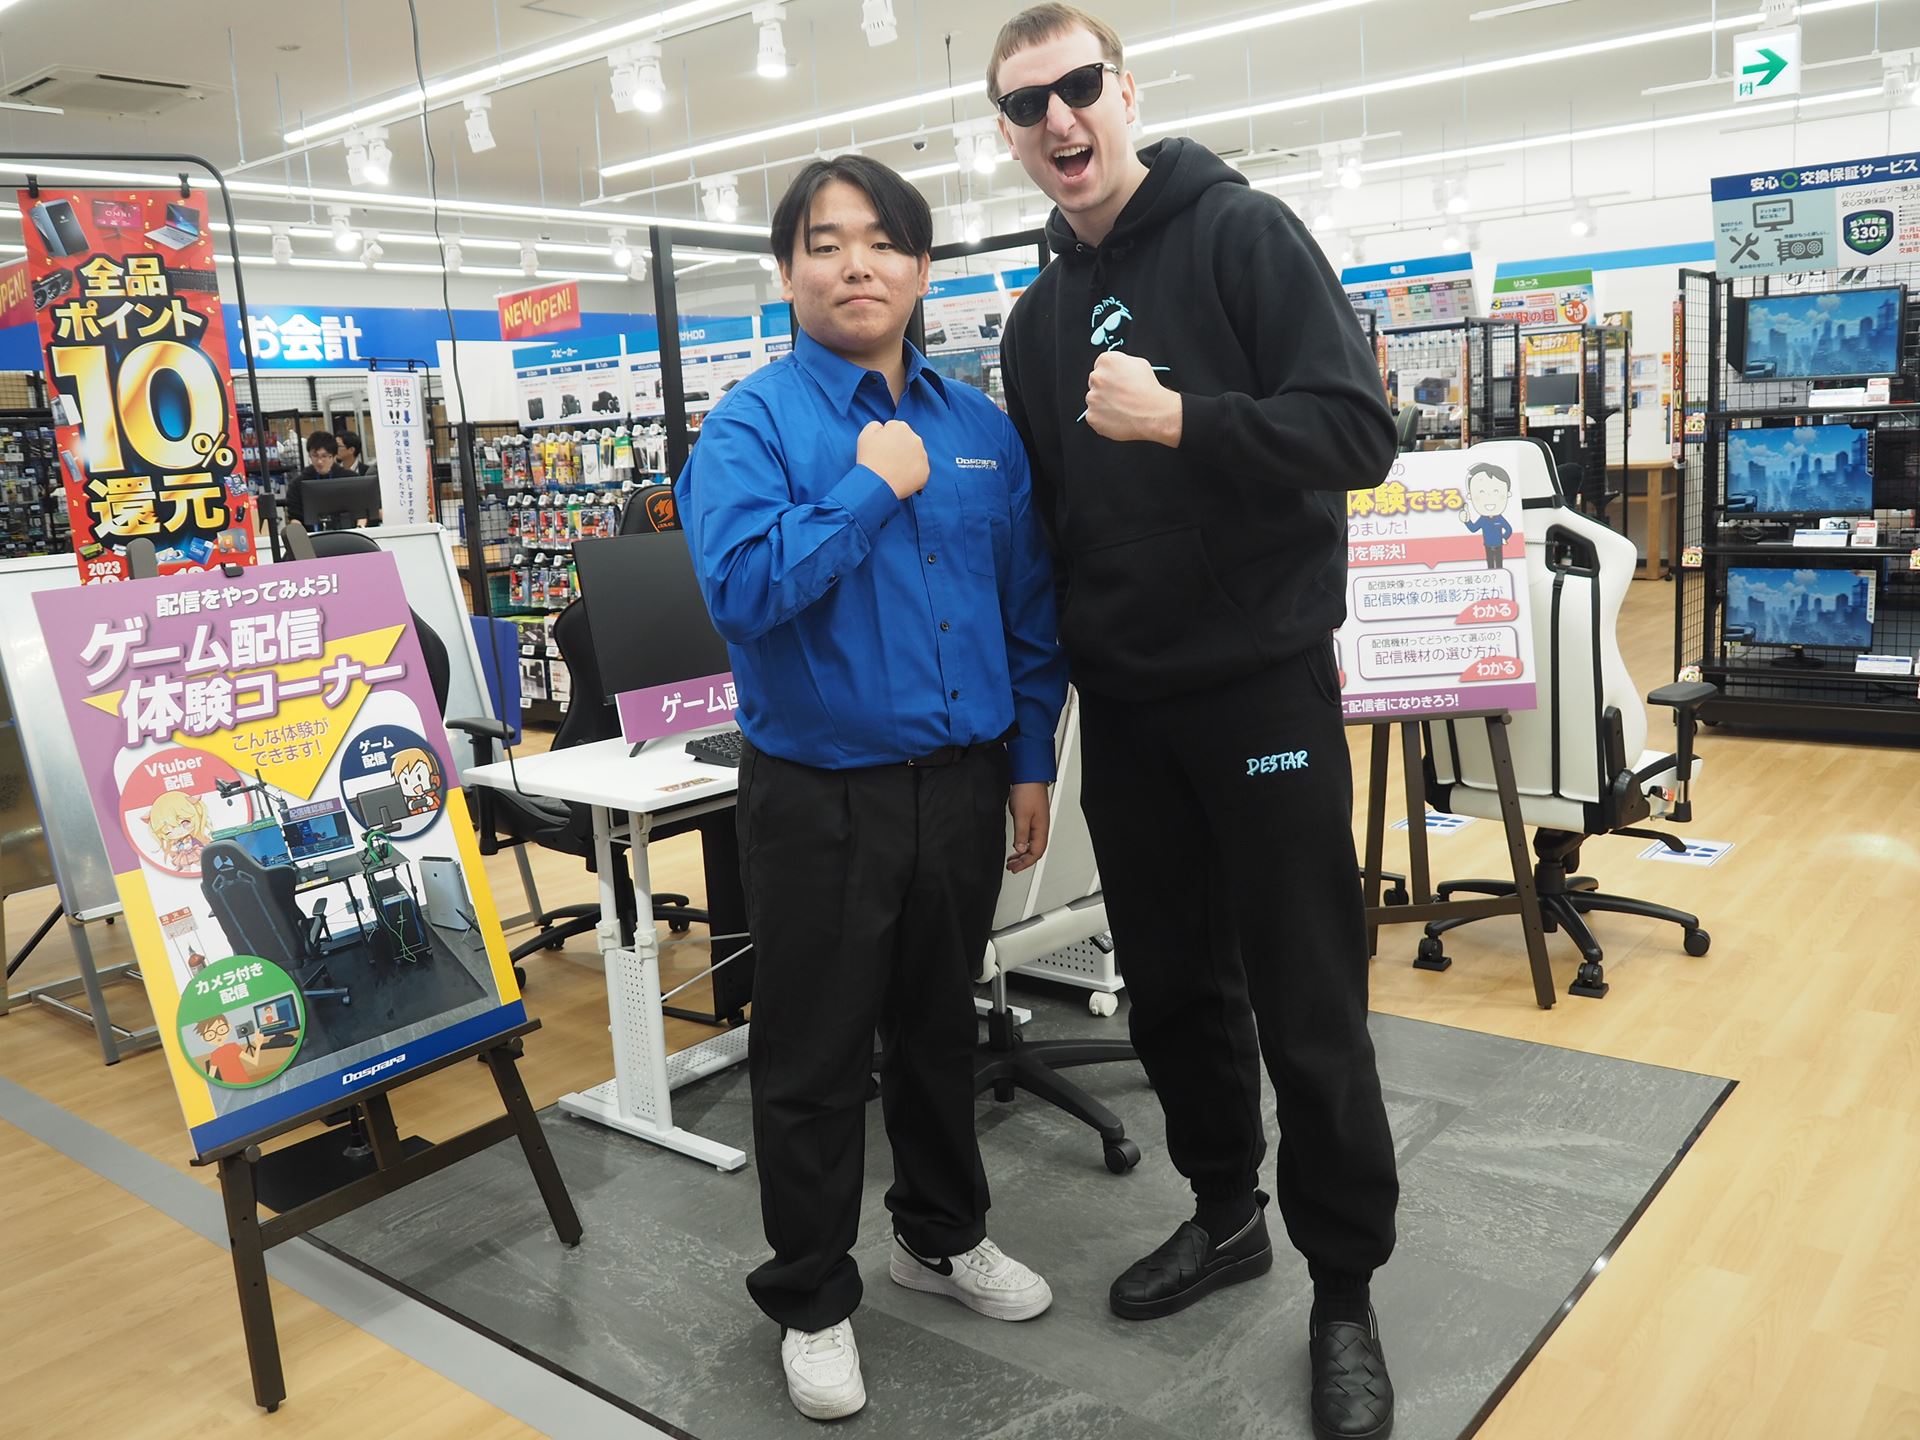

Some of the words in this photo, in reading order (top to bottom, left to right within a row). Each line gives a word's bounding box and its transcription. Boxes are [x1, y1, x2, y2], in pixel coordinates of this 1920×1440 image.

[1750, 175, 1780, 193] 安心
[1800, 158, 1919, 187] 交換保証サービス
[1850, 225, 1888, 240] 330円
[79, 256, 169, 297] 全品
[1513, 278, 1539, 288] リユース
[54, 299, 203, 341] ポイント
[503, 295, 533, 330] NEW
[532, 287, 572, 326] OPEN!
[237, 313, 363, 362] お会計
[550, 347, 578, 359] スピーカー
[51, 340, 234, 474] 10%
[385, 397, 411, 409] コチラ
[84, 472, 225, 538] 還元
[1347, 480, 1463, 517] 体験できる
[87, 561, 121, 577] 2023
[1367, 573, 1498, 591] 配信映像ってどうやって撮るの?
[155, 573, 339, 618] 配信をやってみよう!
[1363, 586, 1504, 608] 配信映像の撮影方法が
[1472, 602, 1512, 618] わかる
[79, 607, 321, 687] ゲーム配信
[1371, 631, 1502, 649] 配信機材ってどうやって選ぶの?
[1375, 644, 1502, 666] 配信機材の選び方が
[1476, 660, 1516, 676] わかる
[121, 656, 404, 744] 体験コーナー
[231, 718, 330, 751] こんな体験が
[359, 736, 395, 754] ゲーム
[251, 739, 323, 767] できます!
[361, 751, 388, 769] 配信
[1246, 749, 1309, 776] DESTAR
[144, 756, 203, 778] Vtuber
[163, 771, 195, 792] 配信
[195, 962, 263, 996] カメラ付き
[218, 982, 250, 1005] 配信
[342, 1053, 406, 1086] Dospara
